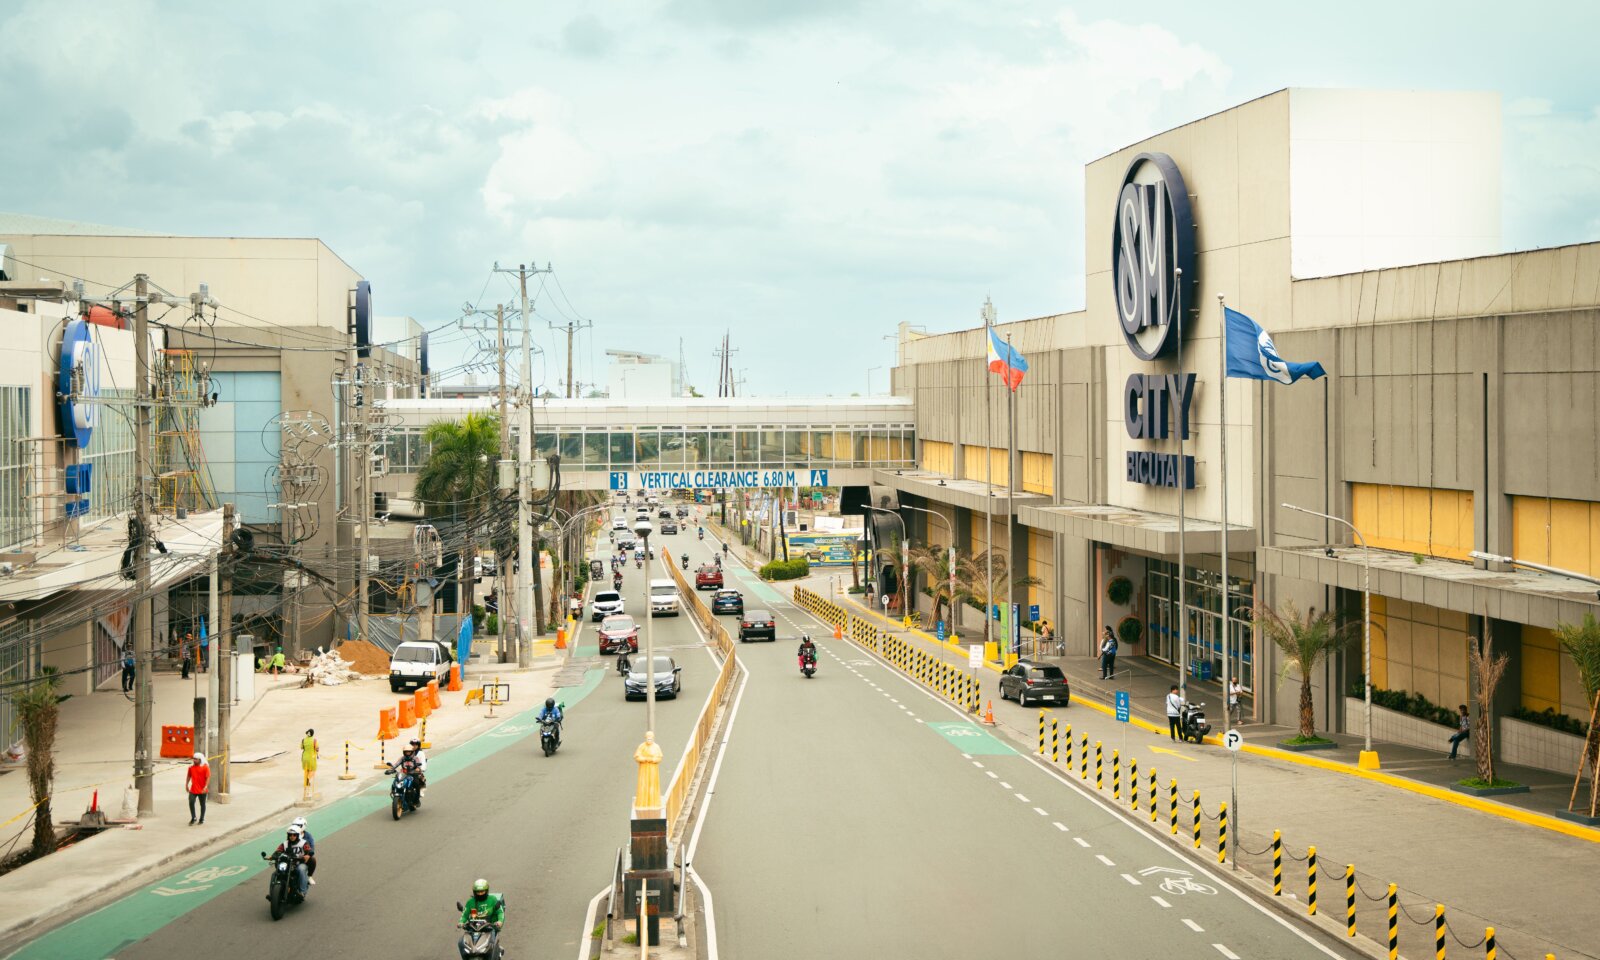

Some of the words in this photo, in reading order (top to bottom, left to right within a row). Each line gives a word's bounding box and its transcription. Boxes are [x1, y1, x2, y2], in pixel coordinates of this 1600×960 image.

[1117, 180, 1171, 335] SM
[1124, 373, 1197, 441] CITY
[617, 472, 626, 489] B
[640, 471, 692, 489] VERTICAL
[694, 471, 758, 488] CLEARANCE
[763, 471, 783, 487] 6.80
[786, 471, 799, 487] M.
[813, 470, 824, 487] A
